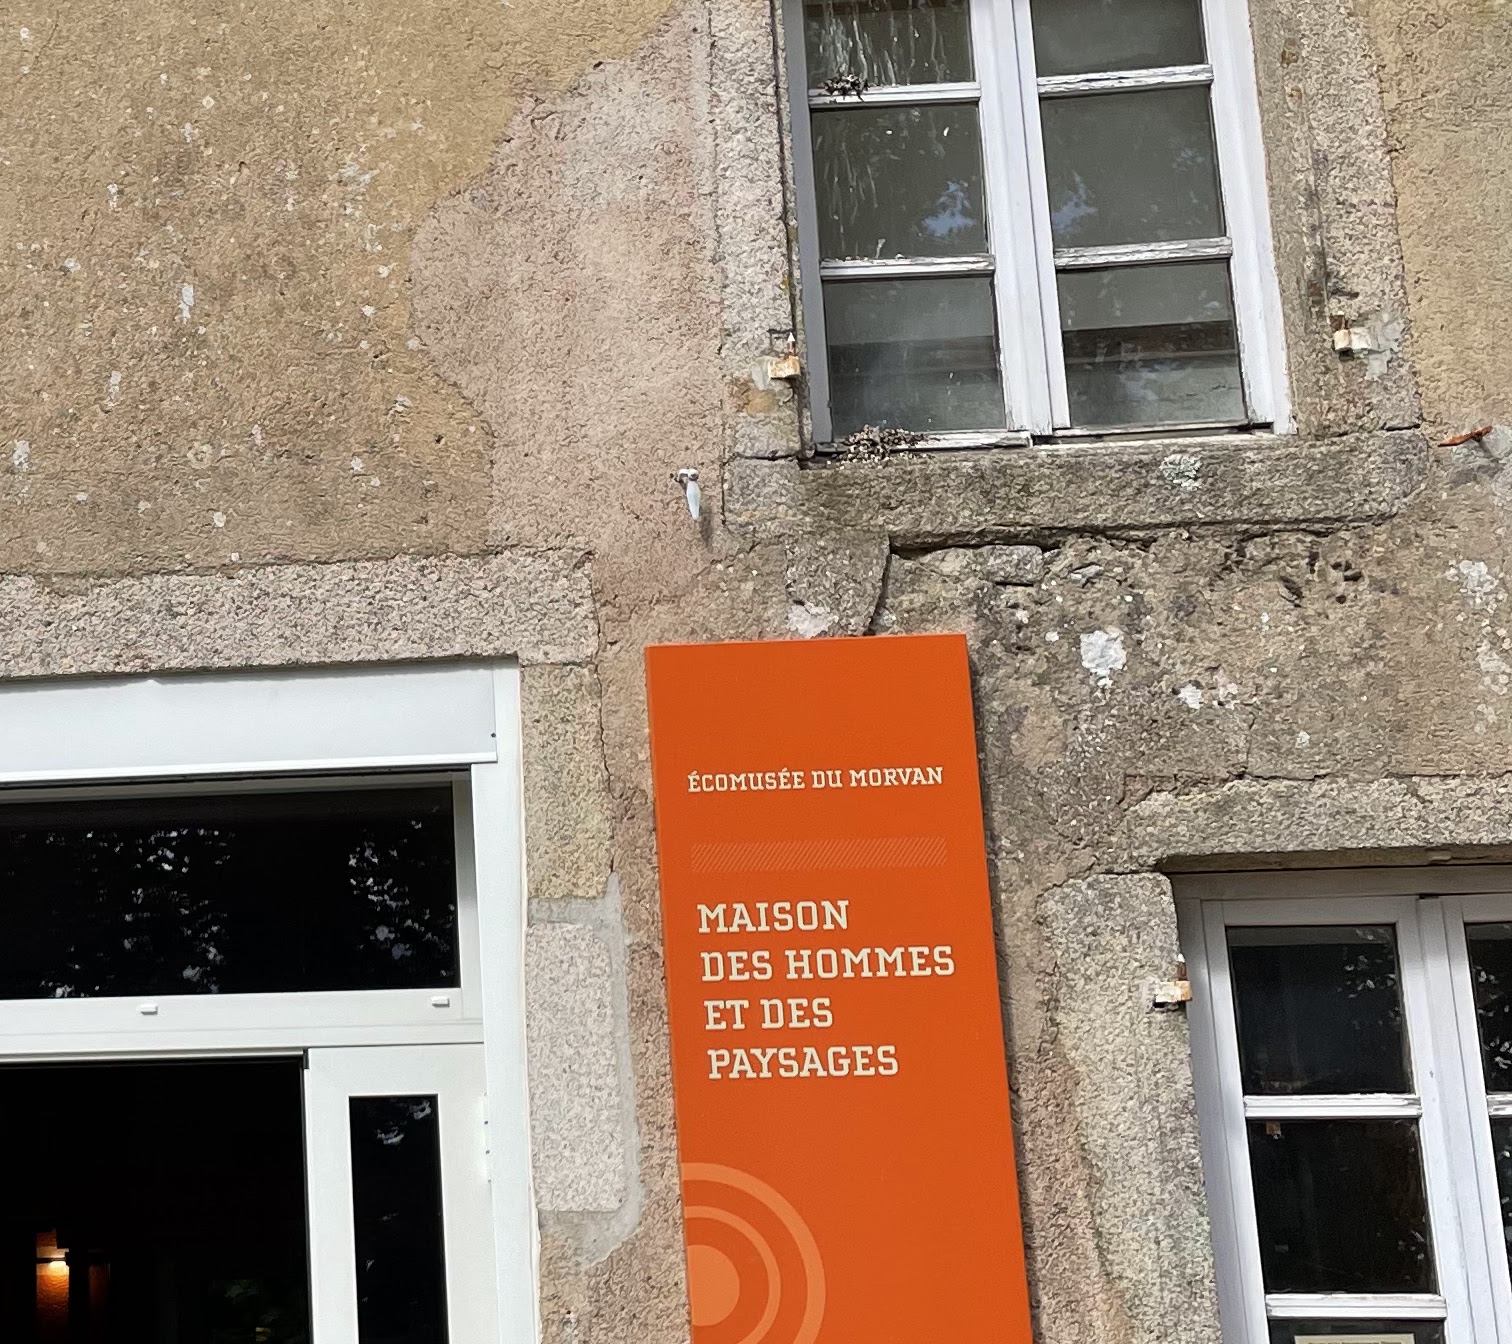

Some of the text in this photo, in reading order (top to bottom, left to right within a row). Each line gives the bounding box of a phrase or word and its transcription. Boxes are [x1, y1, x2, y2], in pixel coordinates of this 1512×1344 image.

[687, 766, 944, 793] ÉCOMUSÉE DU MORVAN
[696, 899, 850, 934] MAISON
[700, 945, 955, 983] DES HOMMES
[703, 997, 833, 1031] ET DES
[707, 1044, 899, 1080] PAYSAGES
